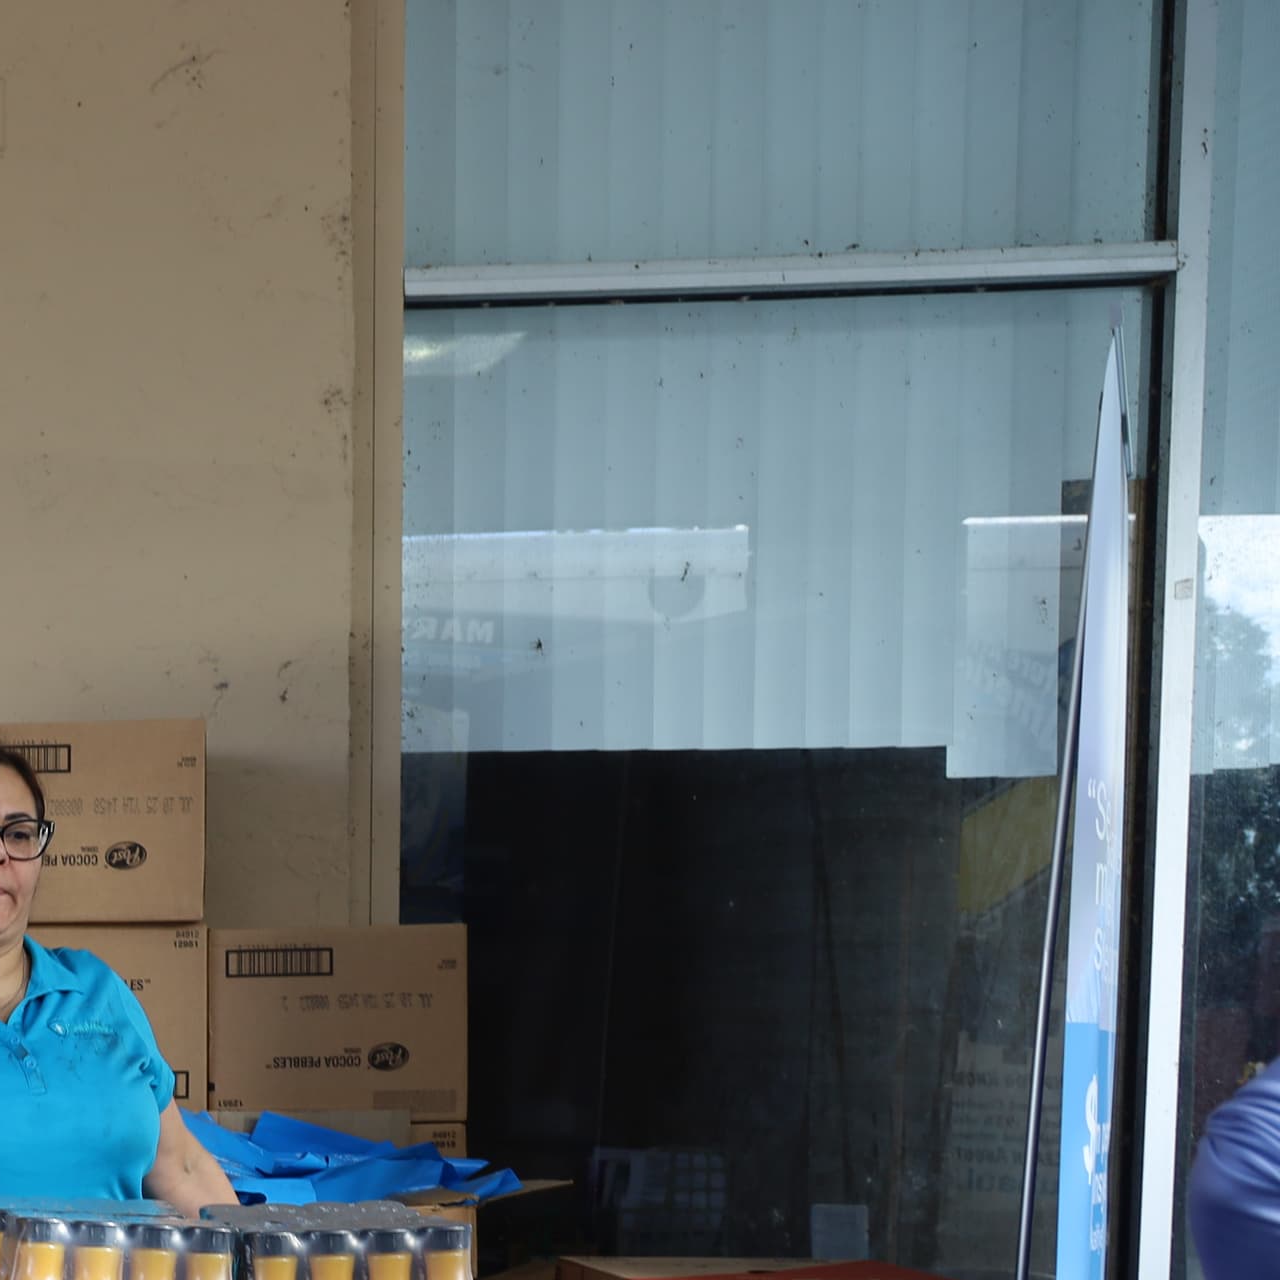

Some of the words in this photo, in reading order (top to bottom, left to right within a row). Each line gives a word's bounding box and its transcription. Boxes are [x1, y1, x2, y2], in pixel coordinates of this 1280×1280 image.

[60, 853, 99, 867] COCOA
[272, 1056, 321, 1070] PEBBLES
[324, 1056, 361, 1068] COCOA
